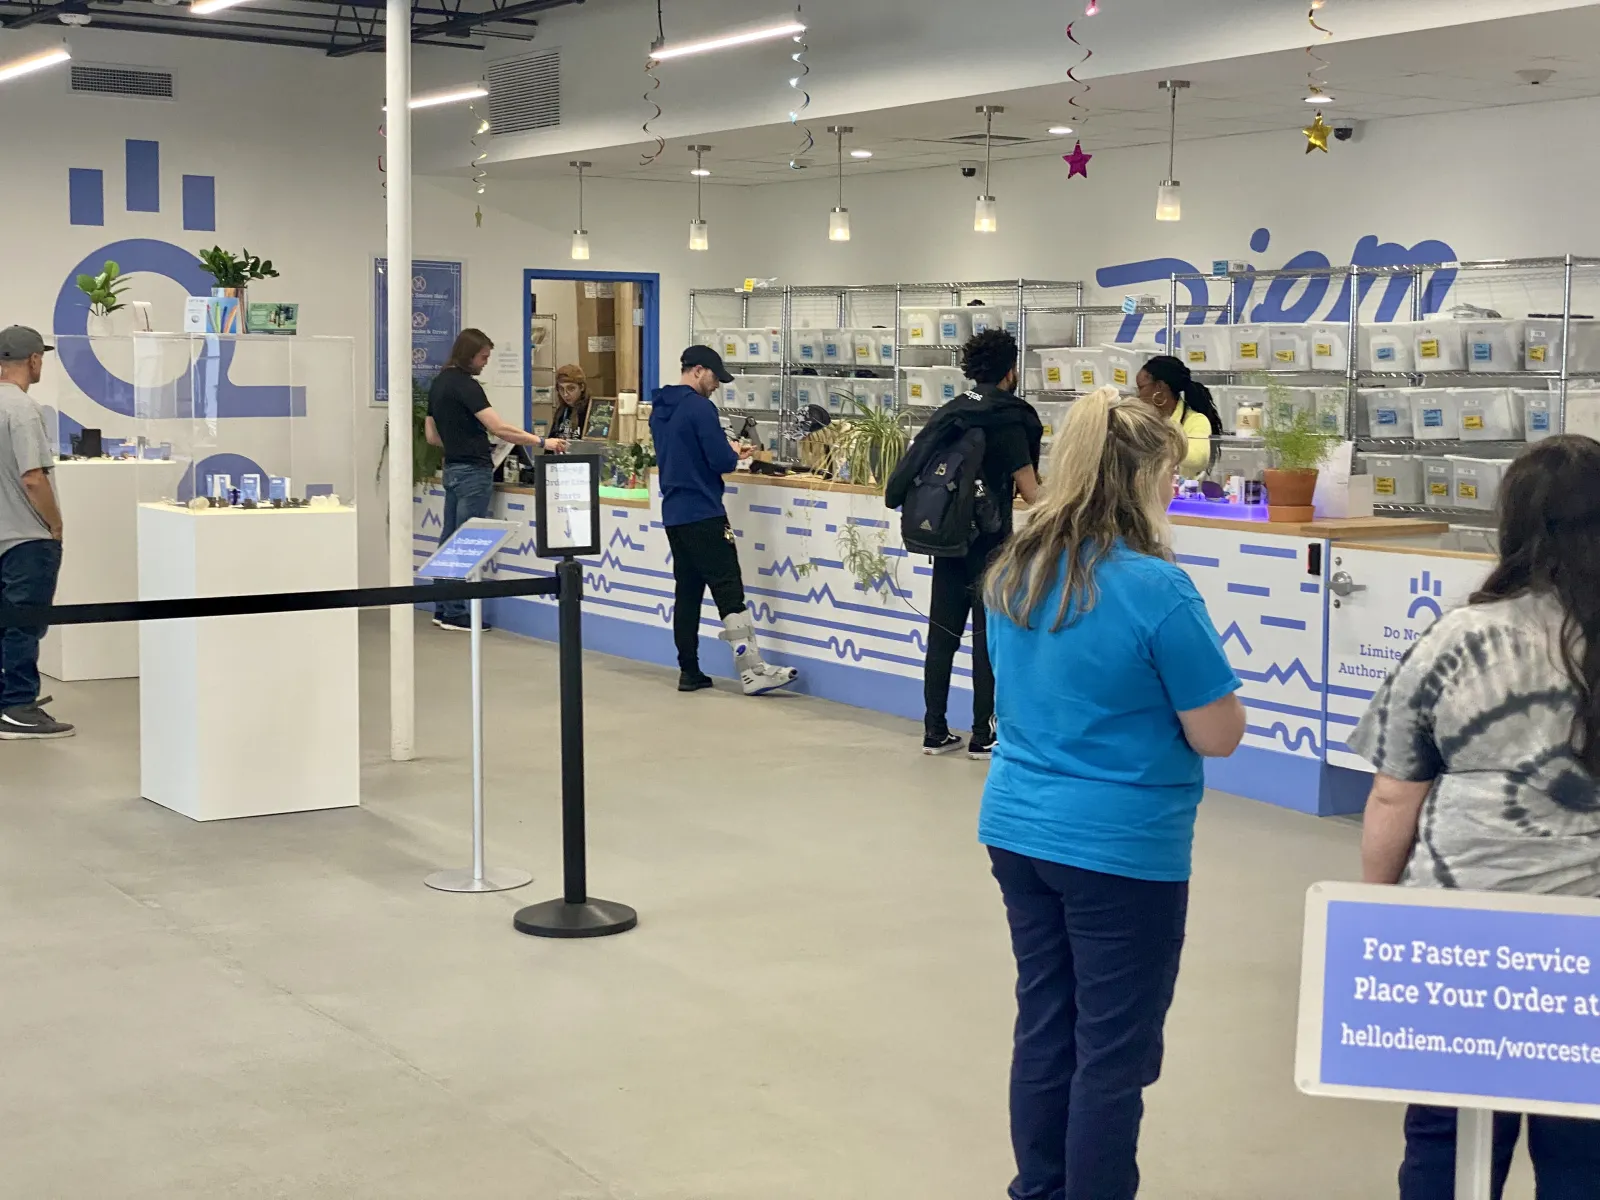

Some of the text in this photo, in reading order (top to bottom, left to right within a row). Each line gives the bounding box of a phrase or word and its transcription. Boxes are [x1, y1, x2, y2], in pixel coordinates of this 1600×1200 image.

[1383, 626, 1421, 641] Do No
[1360, 644, 1402, 660] Limite
[1338, 662, 1389, 679] Authori
[1363, 937, 1591, 974] For Faster Service
[1353, 976, 1600, 1016] Place Your Order at
[1340, 1022, 1600, 1065] hellodiem.com/worceste
